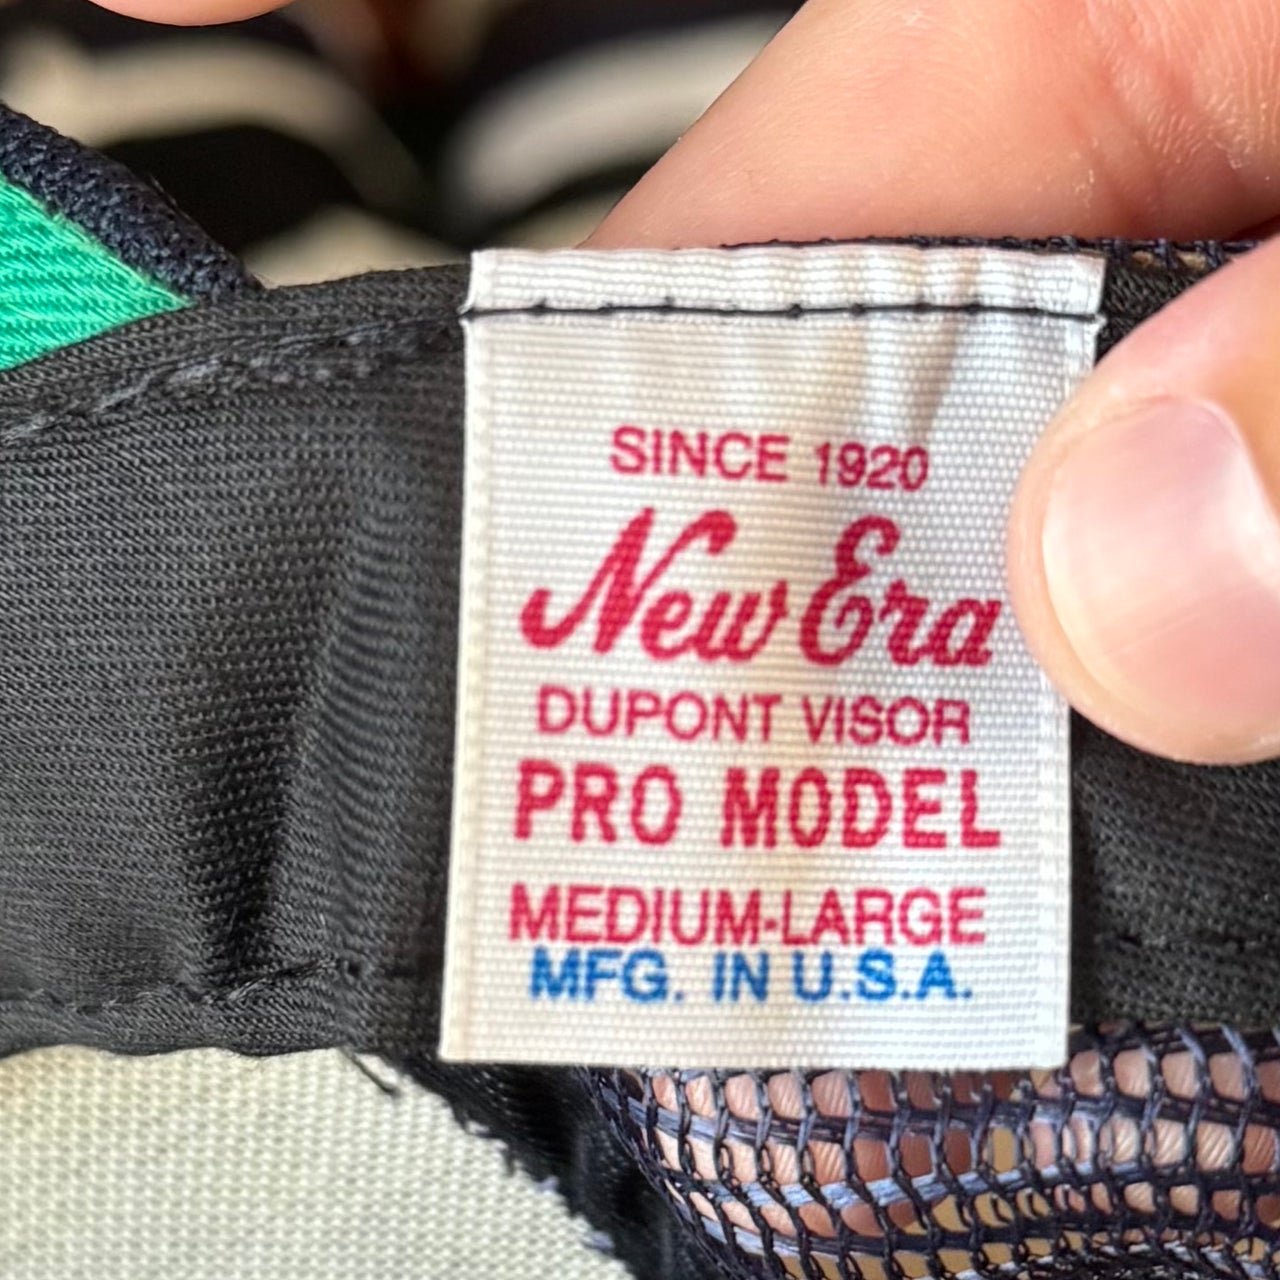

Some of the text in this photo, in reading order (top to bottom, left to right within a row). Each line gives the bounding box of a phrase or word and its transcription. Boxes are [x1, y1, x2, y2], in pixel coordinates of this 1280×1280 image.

[611, 426, 928, 491] SINCE 1920
[520, 508, 1002, 667] New Era
[537, 686, 970, 746] DUPONT VISOR
[515, 759, 1000, 849] PRO MODEL
[510, 884, 985, 946] MEDIUM-LARGE
[531, 949, 971, 1002] MFG. IN U.S.A.
